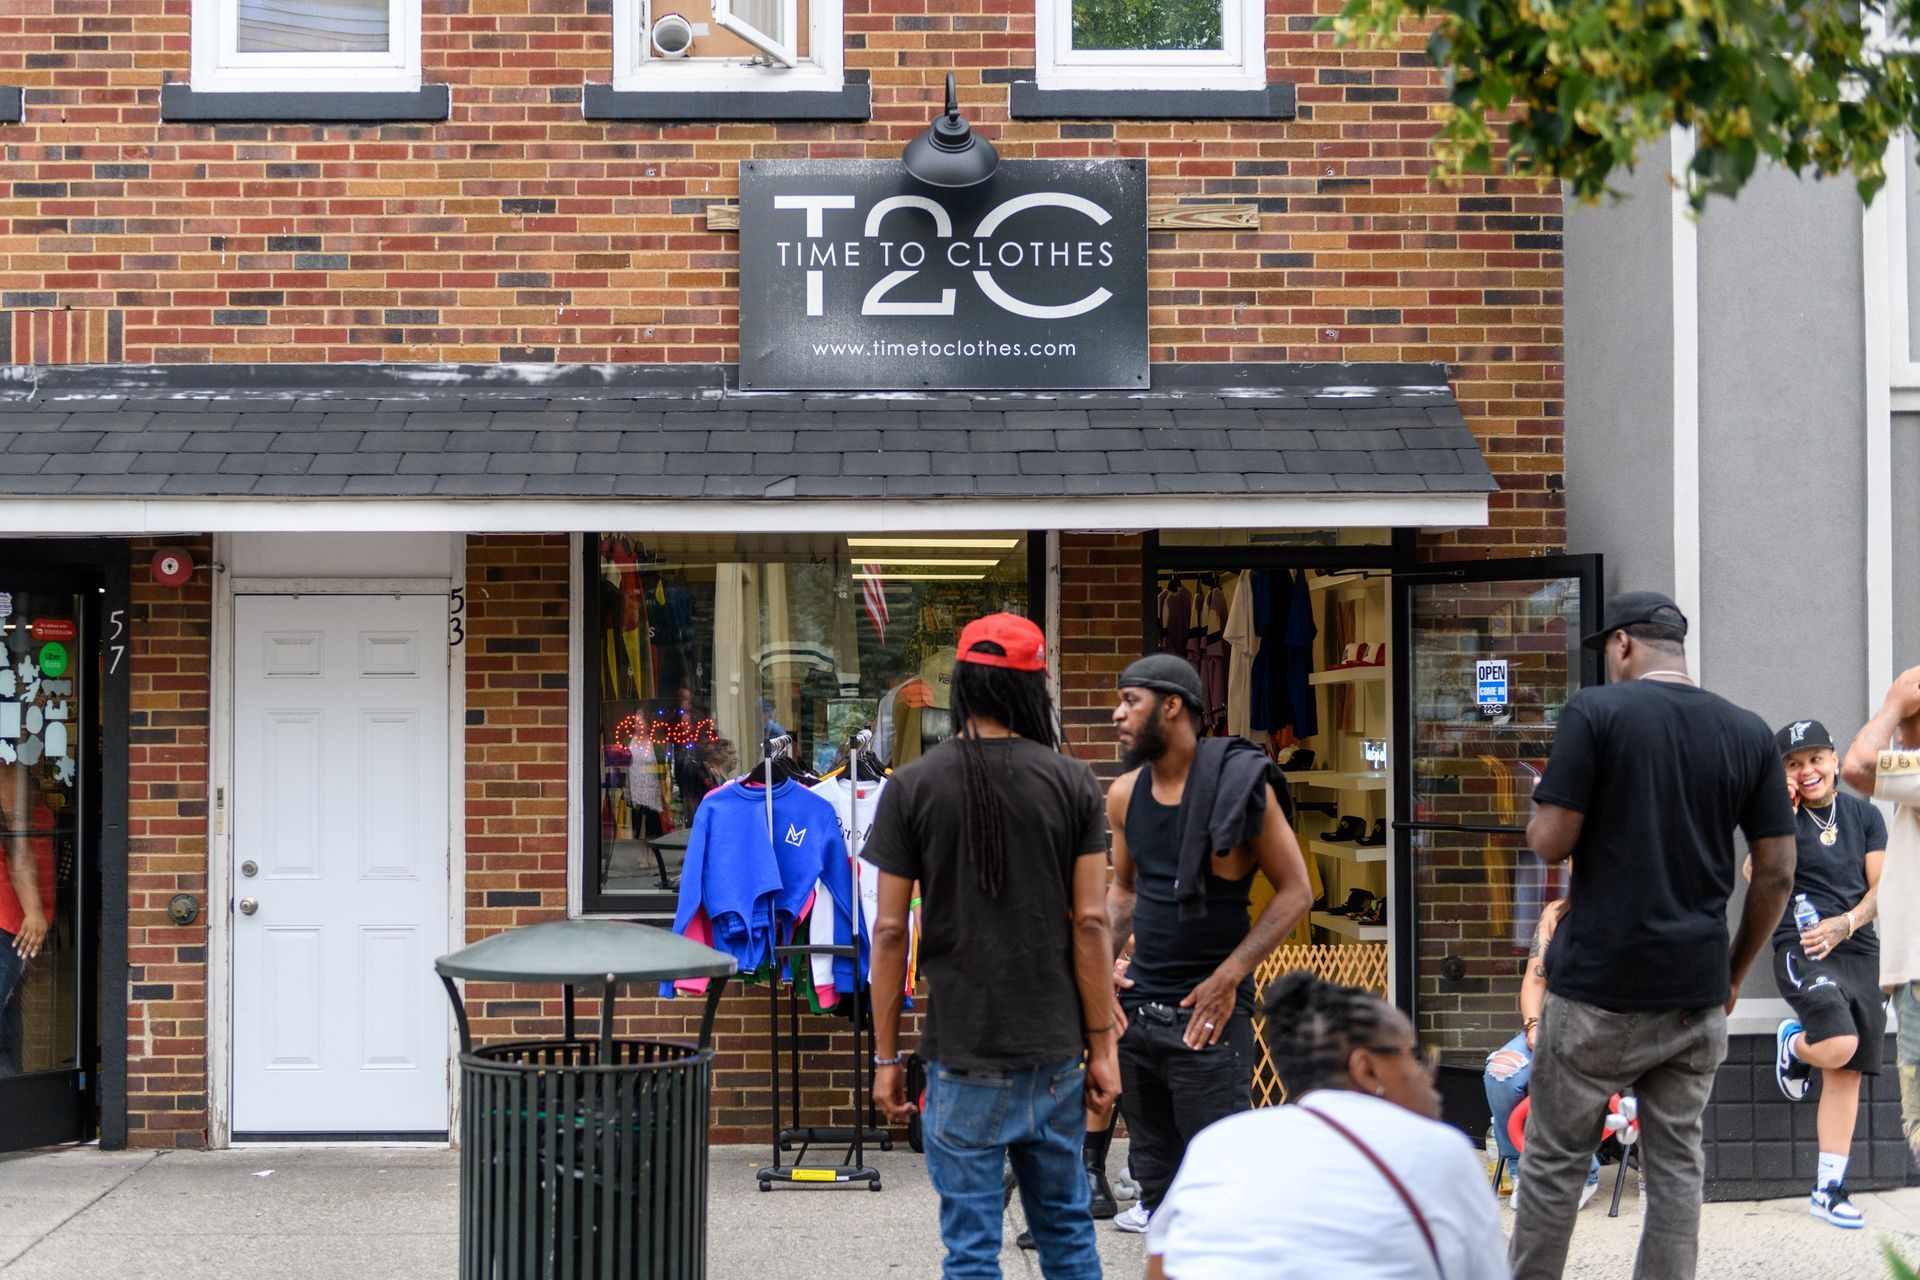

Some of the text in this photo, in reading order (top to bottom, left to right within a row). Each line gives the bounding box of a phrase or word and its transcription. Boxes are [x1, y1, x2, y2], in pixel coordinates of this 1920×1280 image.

[774, 192, 1113, 319] T2C
[776, 241, 1114, 267] TIME TO CLOTHES
[812, 340, 1076, 357] www.timetoclothes.com
[449, 587, 464, 646] 53
[110, 610, 125, 675] 57
[1479, 666, 1505, 680] OPEN
[1479, 687, 1505, 696] COME IN
